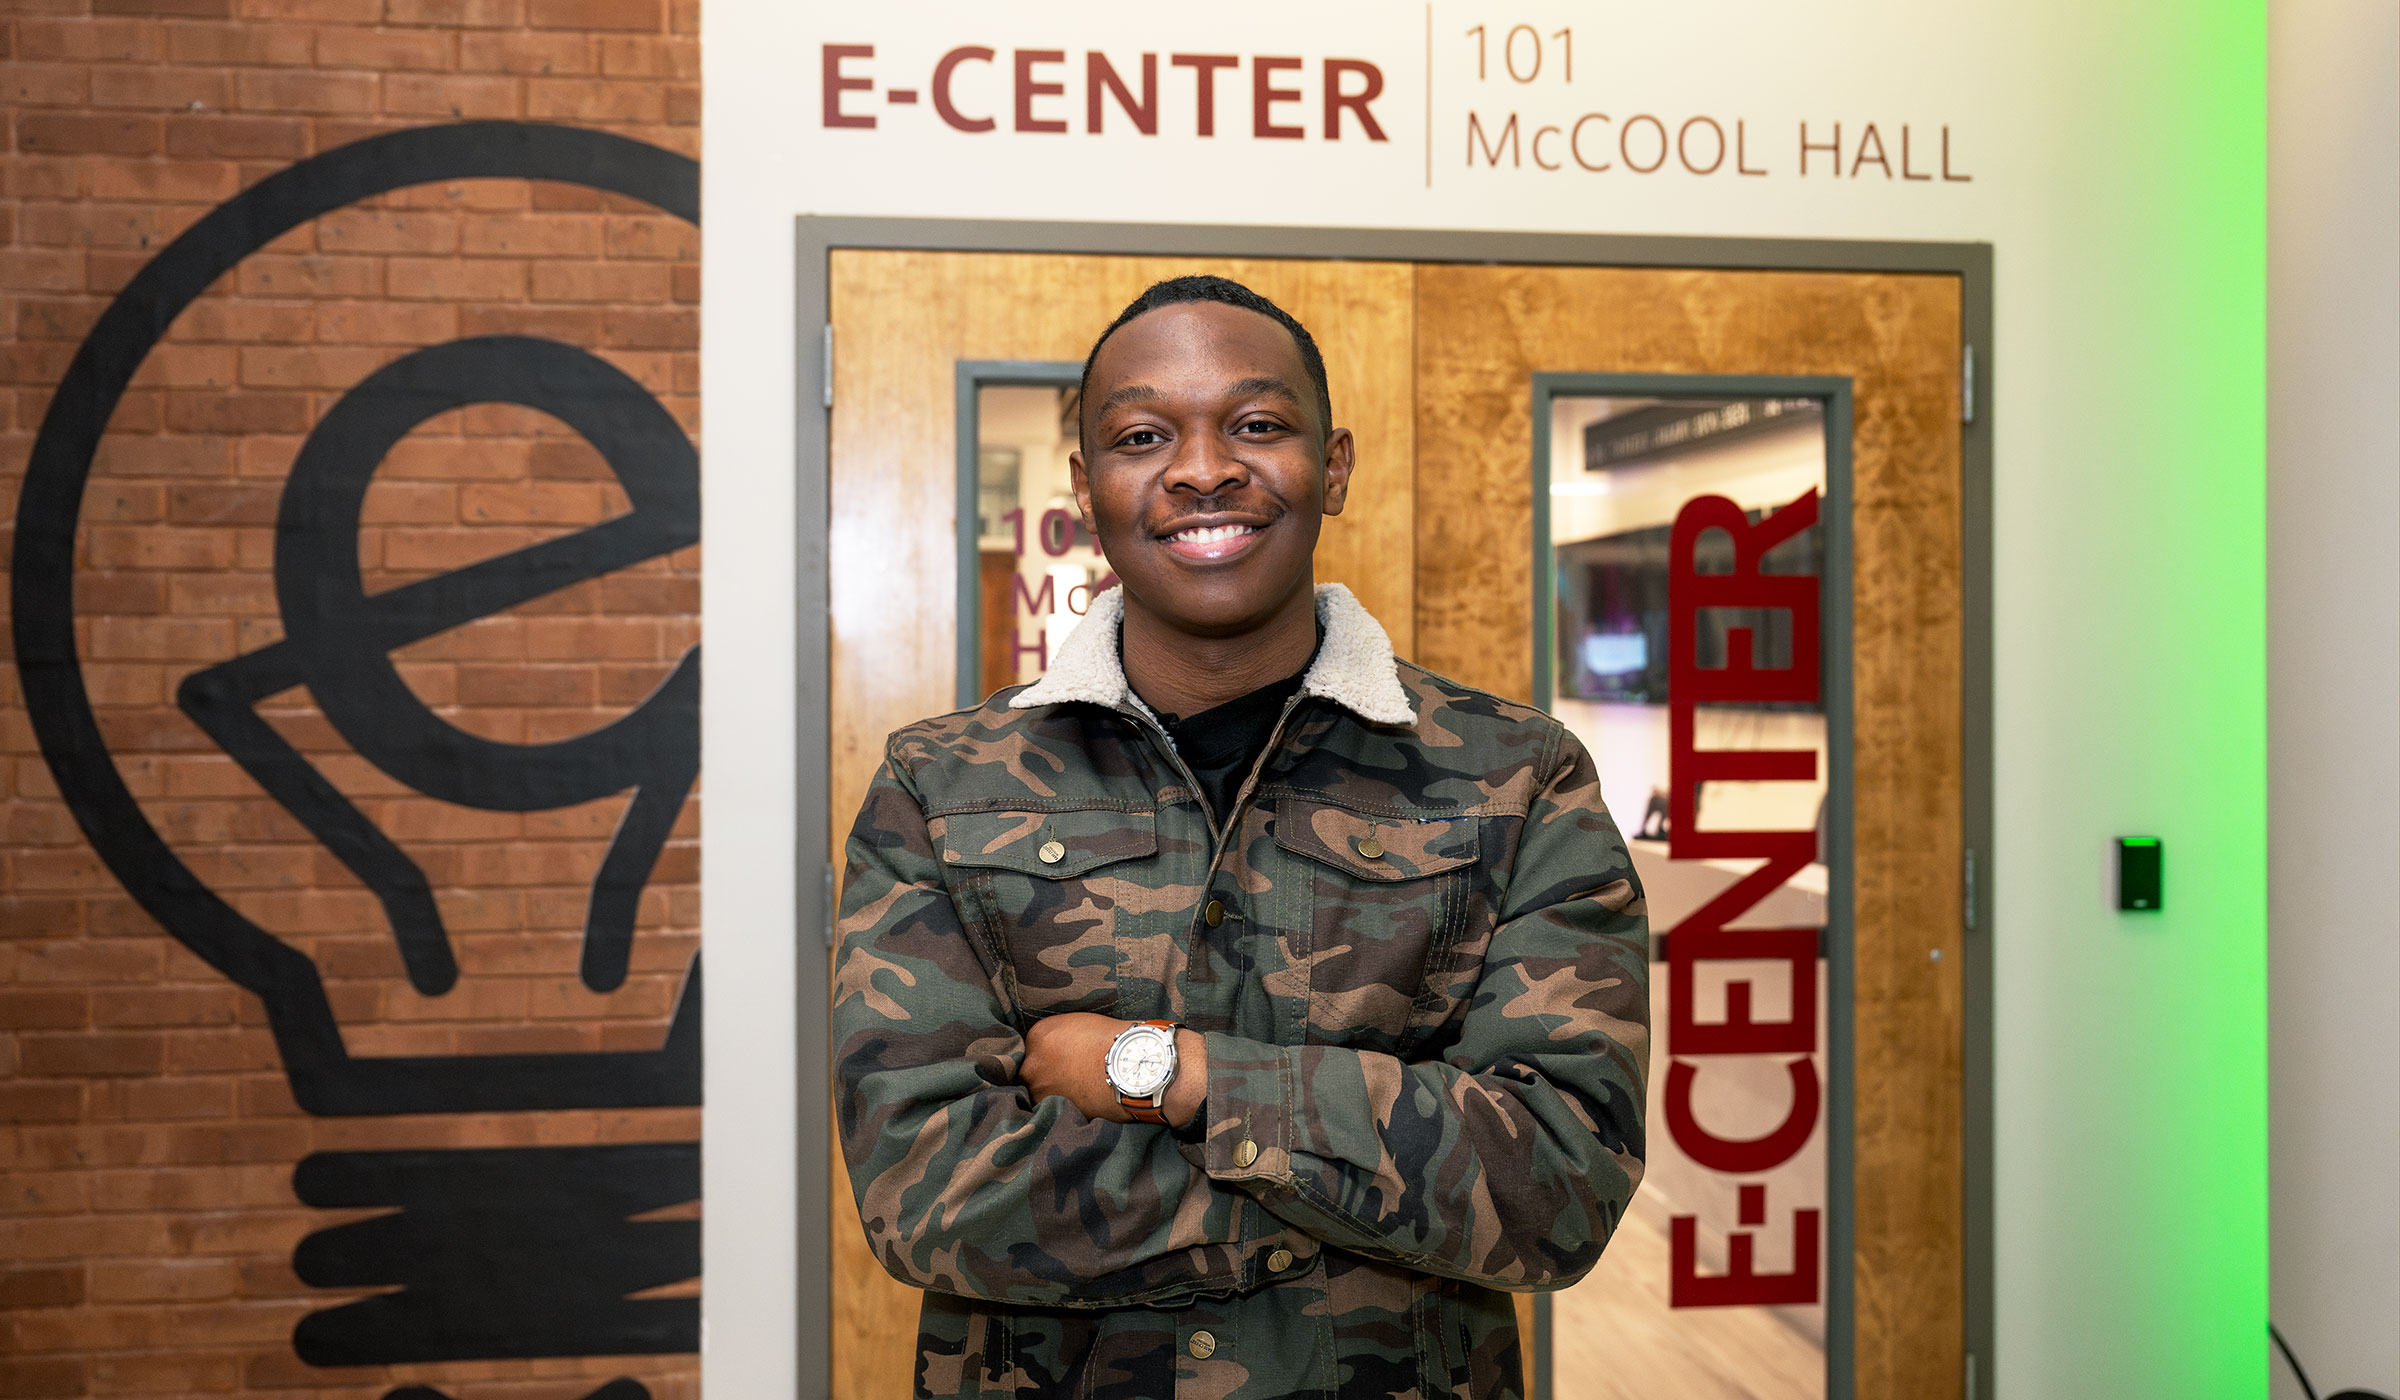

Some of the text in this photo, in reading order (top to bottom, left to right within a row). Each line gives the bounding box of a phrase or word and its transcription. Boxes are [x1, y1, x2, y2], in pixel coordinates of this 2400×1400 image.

[1466, 25, 1574, 82] 101
[822, 43, 1389, 143] E-CENTER
[1467, 111, 1973, 183] McCOOL HALL
[1011, 573, 1120, 615] Mc
[1664, 487, 1821, 1309] E-CENTER
